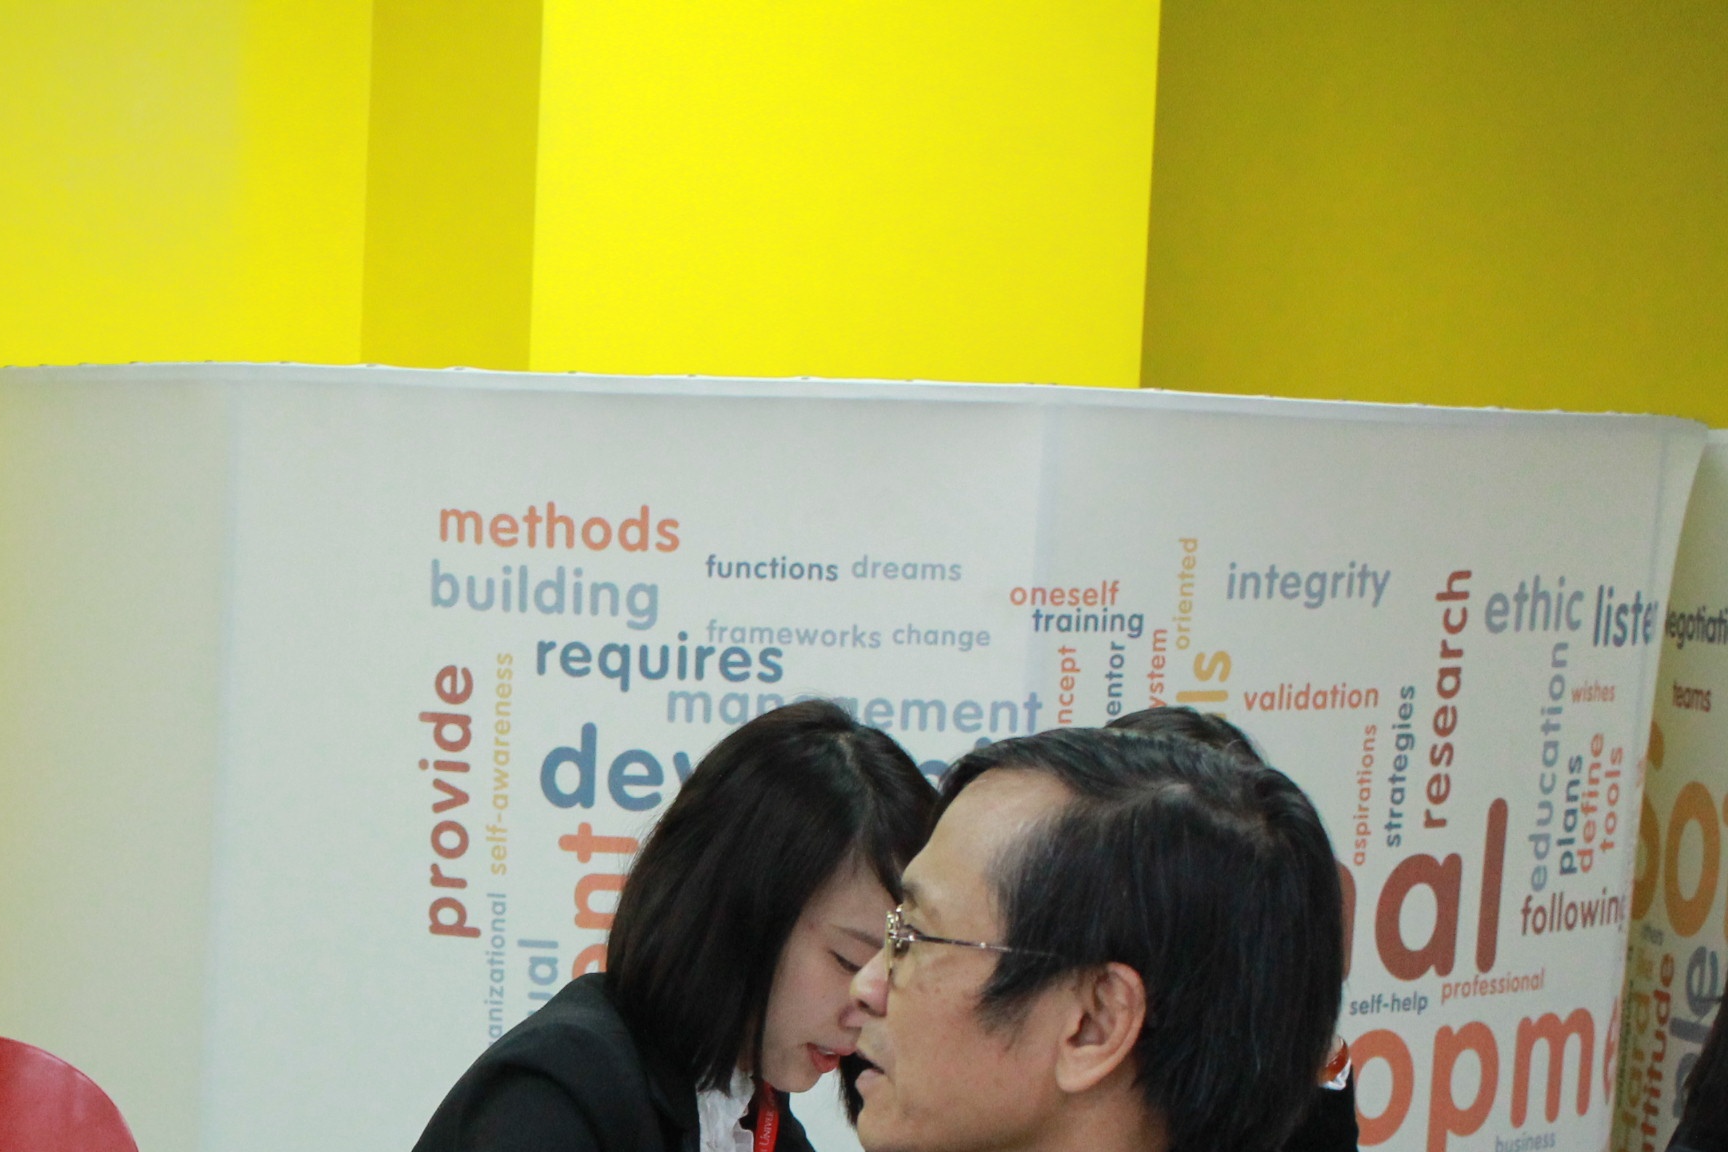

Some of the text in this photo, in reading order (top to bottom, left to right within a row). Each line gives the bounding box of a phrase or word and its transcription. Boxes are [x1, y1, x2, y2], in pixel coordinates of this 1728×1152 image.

[439, 501, 680, 552] methods
[430, 558, 659, 631] building
[705, 553, 963, 581] functions dreams
[1009, 580, 1120, 606] oneself
[1173, 537, 1199, 650] oriented
[1226, 561, 1391, 609] integrity
[705, 618, 991, 652] frameworks change
[1032, 607, 1145, 639] training
[1484, 574, 1584, 634] ethic
[536, 631, 784, 692] requires
[1105, 641, 1125, 726] entor
[1176, 650, 1232, 720] ls
[1243, 682, 1380, 711] validation
[1572, 681, 1615, 704] wishes
[667, 690, 1043, 734] manement
[1423, 569, 1472, 829] research
[485, 652, 513, 876] self-awareness
[1353, 724, 1377, 867] aspirations
[1383, 685, 1415, 848] strategies
[1528, 641, 1569, 892] education
[419, 664, 482, 938] provide
[1555, 754, 1583, 876] plans
[1577, 732, 1605, 873] define
[1600, 746, 1624, 853] tools
[484, 892, 507, 1046] anizational
[1349, 991, 1429, 1016] self-help
[1440, 967, 1546, 1006] professional
